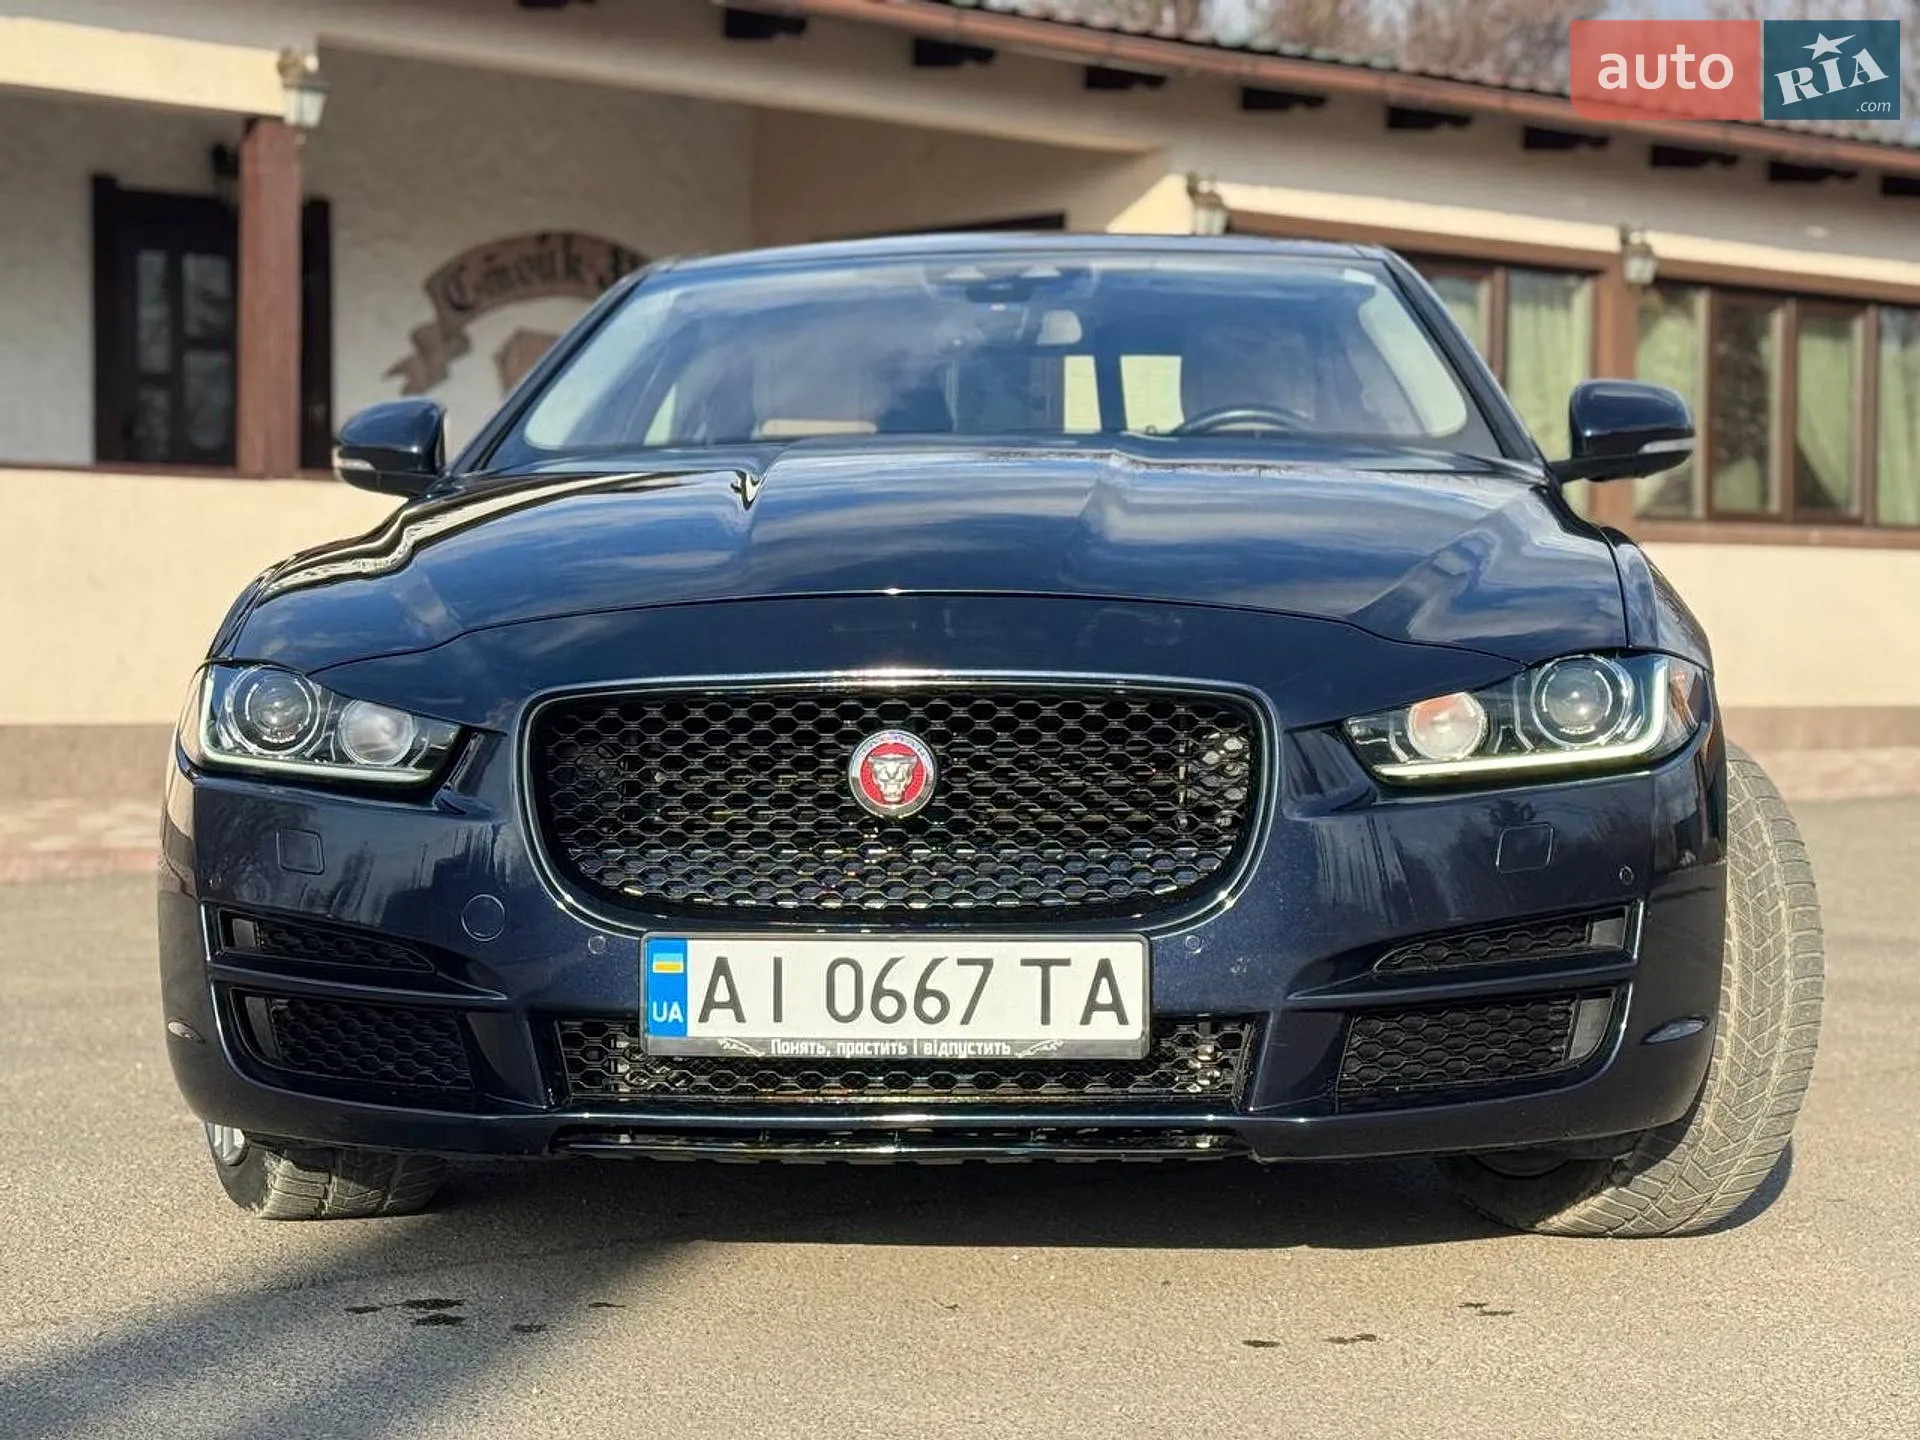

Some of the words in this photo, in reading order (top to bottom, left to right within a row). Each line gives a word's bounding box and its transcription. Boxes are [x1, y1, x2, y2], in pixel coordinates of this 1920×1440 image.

[698, 955, 783, 1024] AI
[825, 955, 994, 1025] 0667
[1020, 957, 1130, 1026] TA
[652, 1001, 684, 1023] UA
[770, 1039, 831, 1058] Понять,
[836, 1041, 907, 1059] простить
